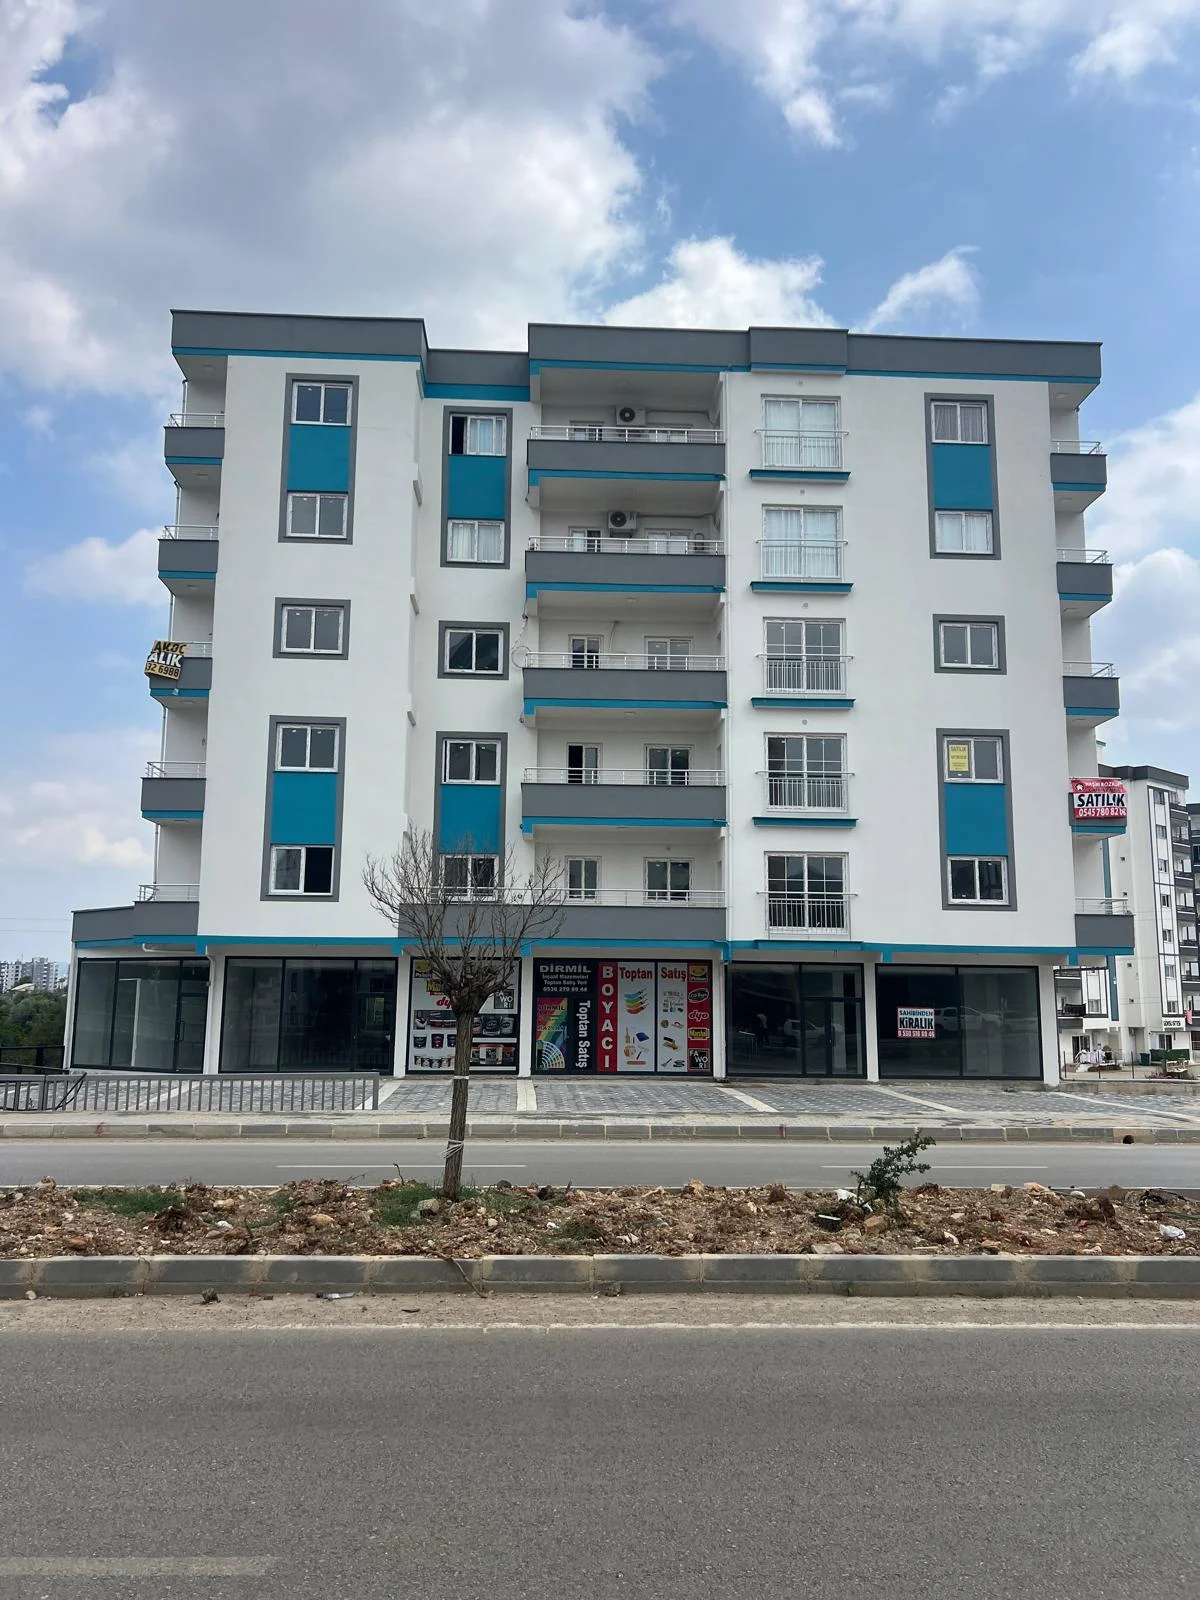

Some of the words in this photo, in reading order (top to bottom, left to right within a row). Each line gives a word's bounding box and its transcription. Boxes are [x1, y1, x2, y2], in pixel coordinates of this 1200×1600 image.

[1078, 794, 1124, 807] SATILIK
[540, 964, 591, 973] DİRMİL
[620, 967, 653, 982] Toptan
[661, 967, 687, 982] Satış
[576, 1000, 591, 1037] Toptan
[689, 1010, 710, 1022] dyo
[575, 1041, 591, 1068] Satış
